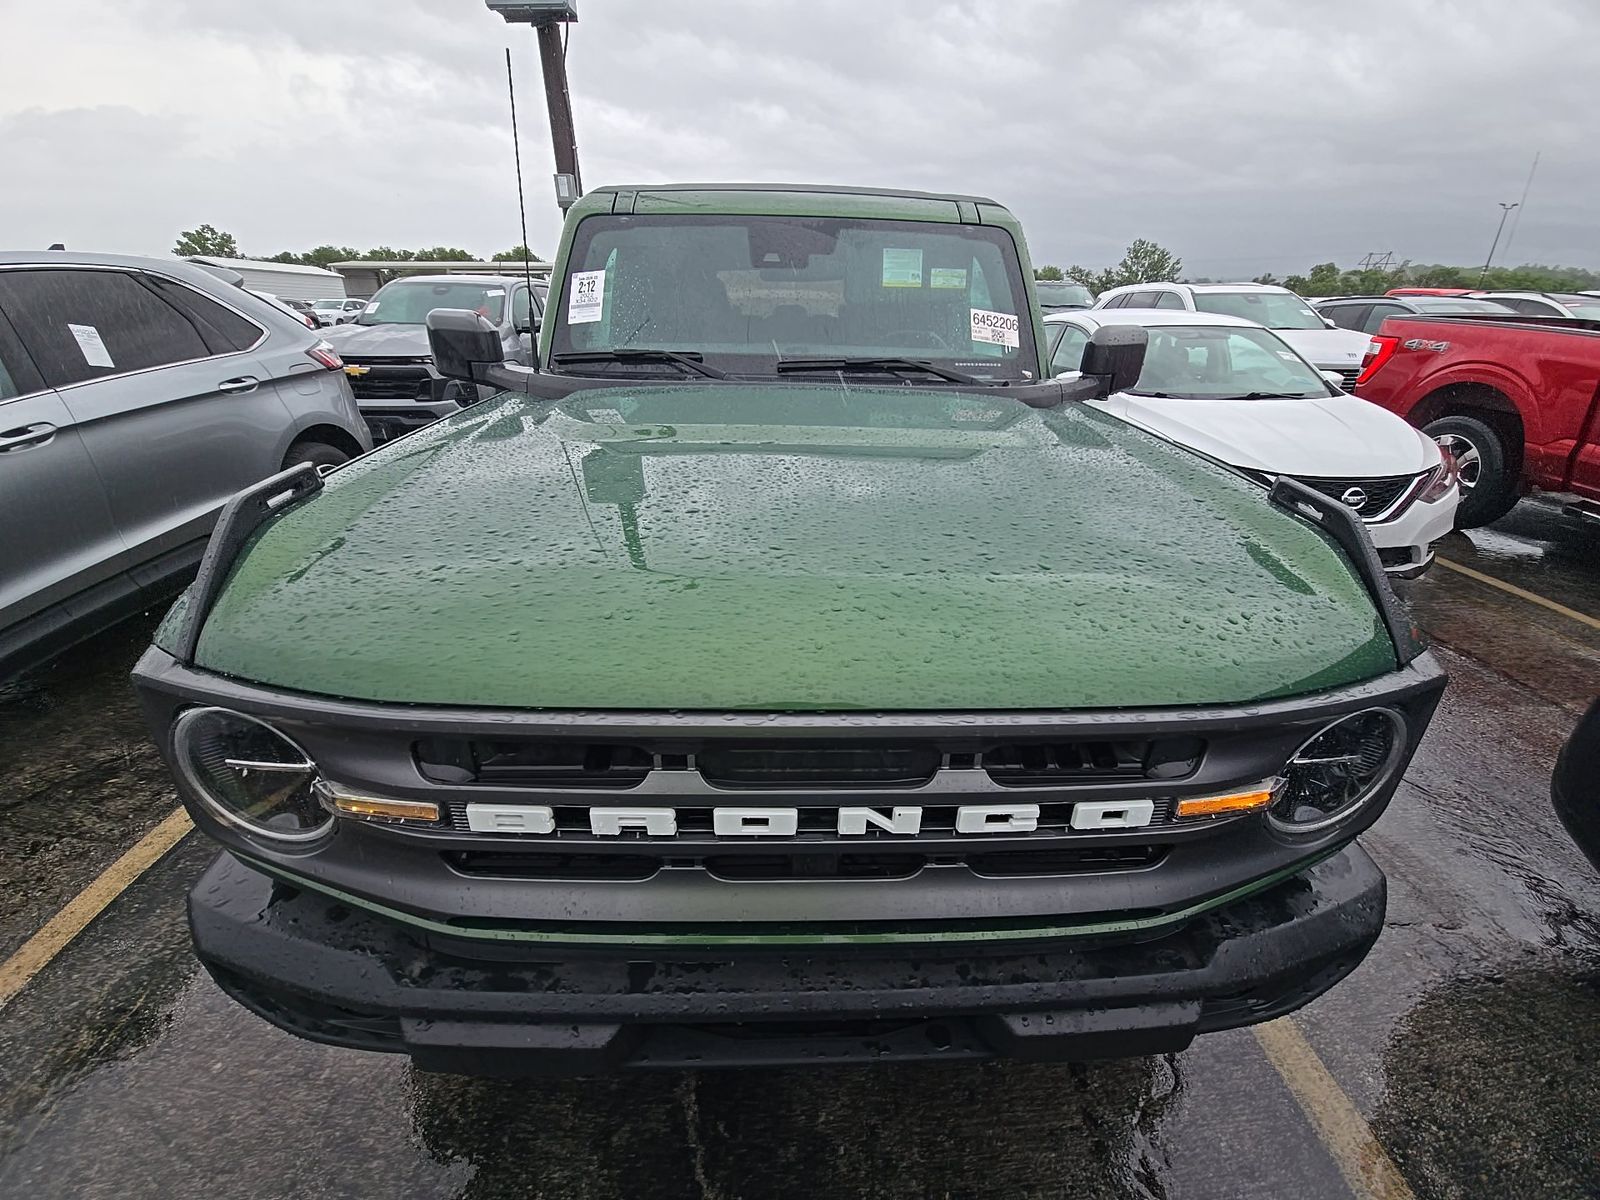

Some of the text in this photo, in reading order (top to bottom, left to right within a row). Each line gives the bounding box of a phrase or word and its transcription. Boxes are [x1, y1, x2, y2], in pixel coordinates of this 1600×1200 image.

[578, 280, 596, 294] 2:12
[973, 313, 1019, 331] 6452206
[466, 800, 1154, 836] BRONCO
